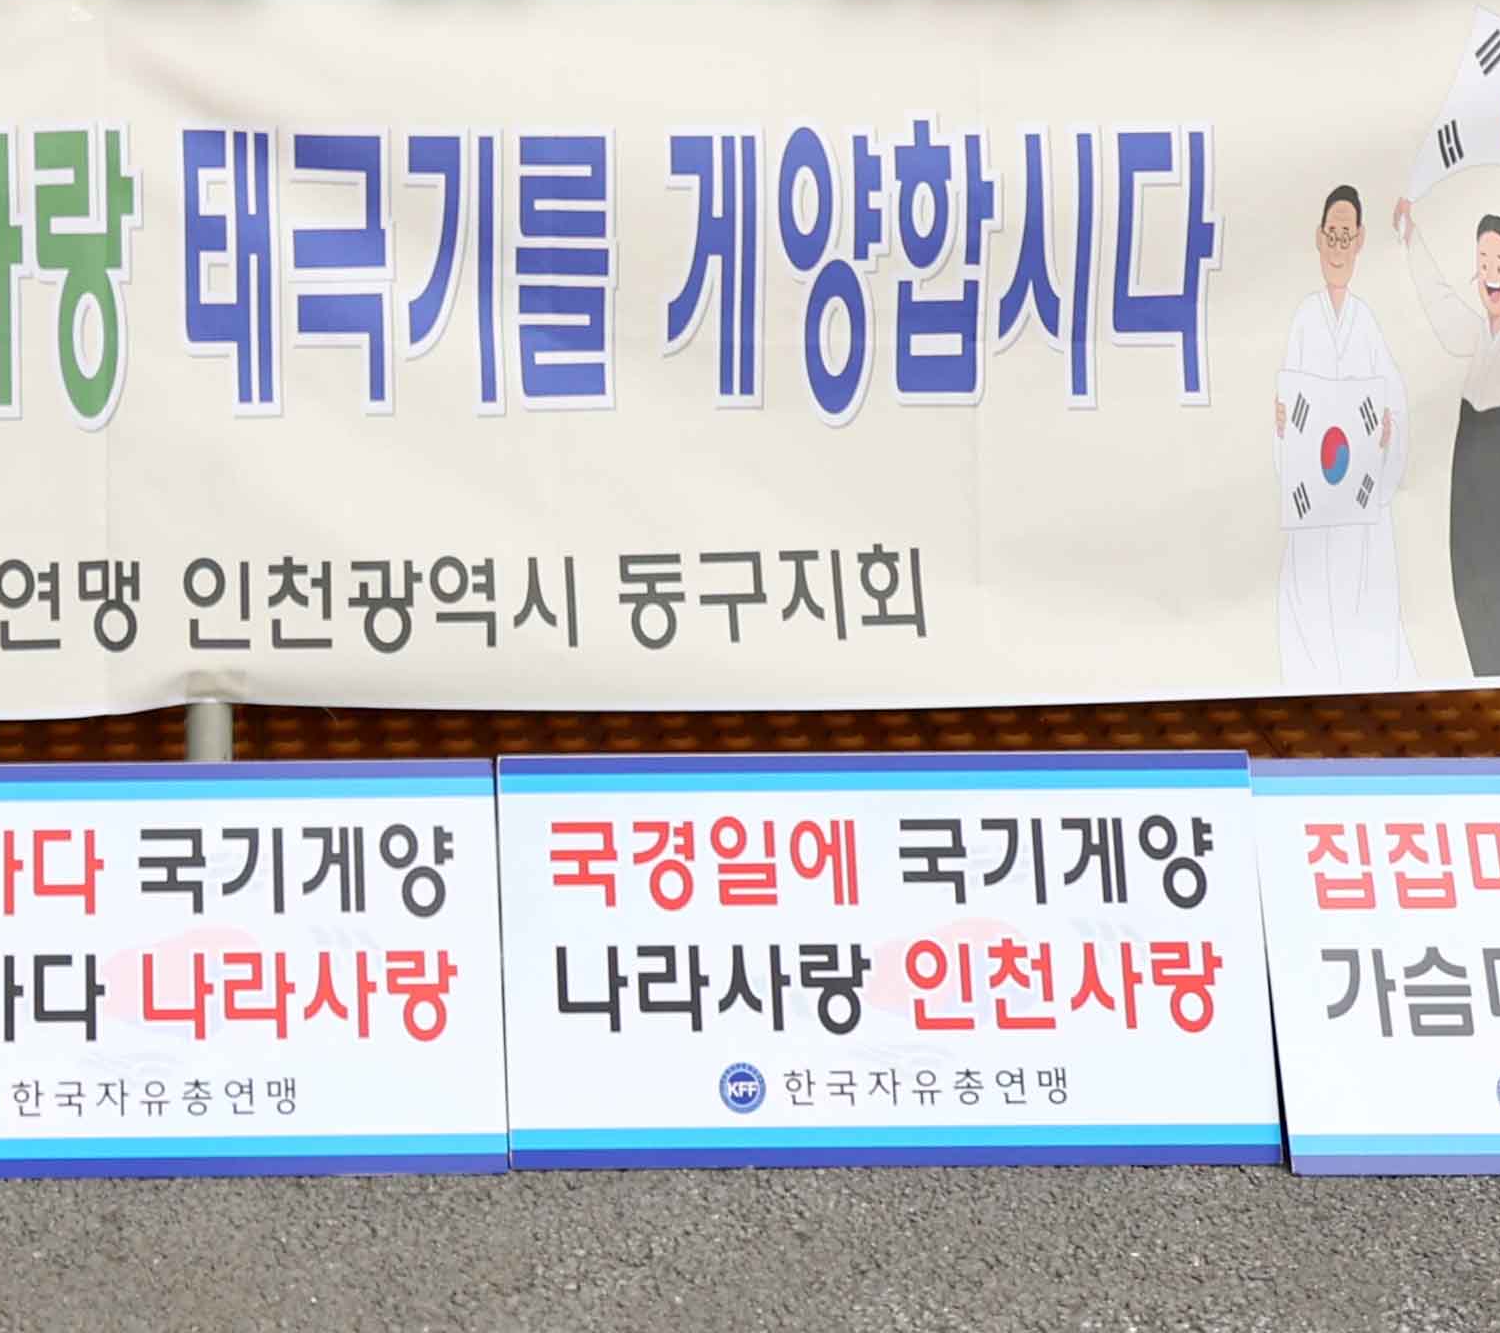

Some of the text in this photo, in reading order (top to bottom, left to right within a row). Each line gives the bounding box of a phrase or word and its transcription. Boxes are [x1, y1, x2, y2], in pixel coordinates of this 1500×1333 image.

[184, 130, 609, 402] 태극기를
[669, 121, 1214, 413] 게양합시다
[184, 556, 577, 653] 인천광역시
[618, 544, 929, 641] 동구지회
[139, 825, 453, 917] 국기게양
[551, 815, 1213, 910] 국경일에 국기게양
[143, 951, 457, 1041] 나라사랑
[556, 939, 1222, 1034] 나라사랑 인천사랑
[11, 1077, 298, 1118] 한국자유총연맹
[725, 1081, 761, 1097] KFF
[786, 1069, 1066, 1104] 한국자유총연맹
